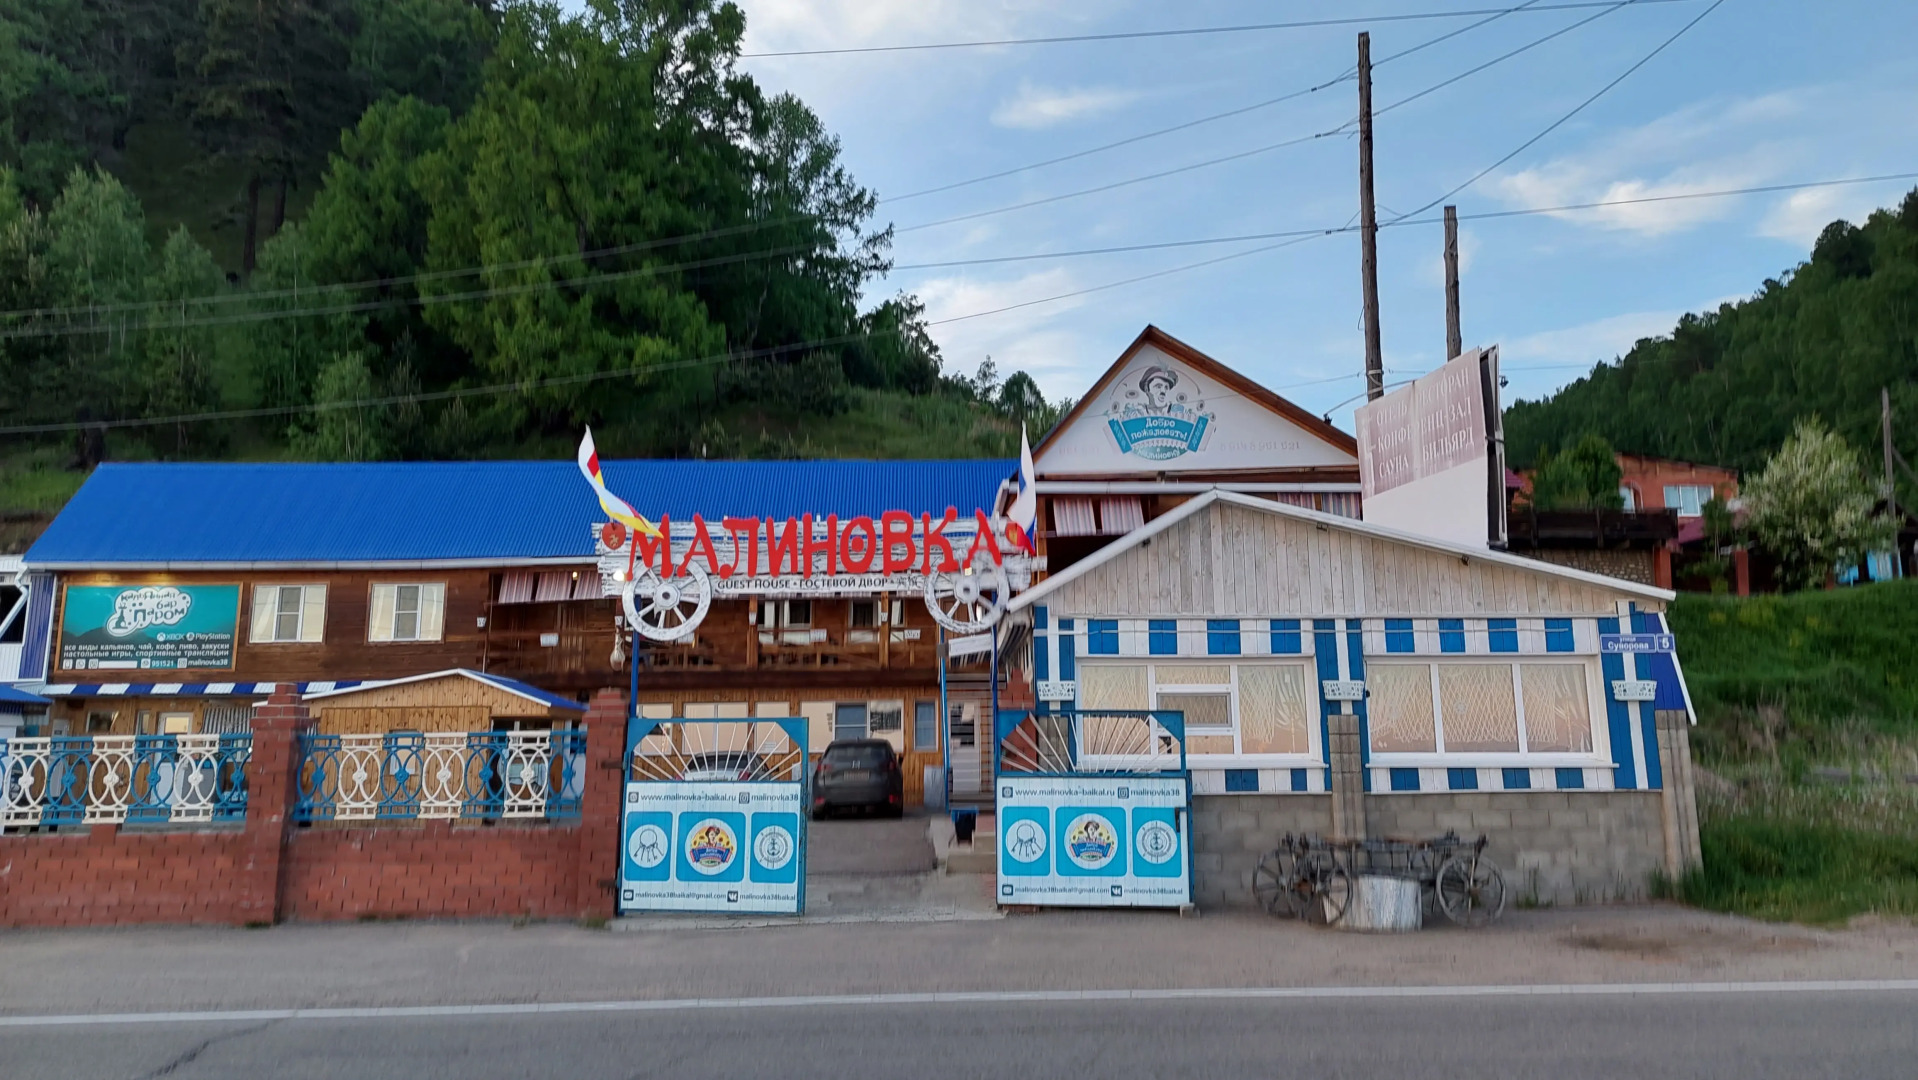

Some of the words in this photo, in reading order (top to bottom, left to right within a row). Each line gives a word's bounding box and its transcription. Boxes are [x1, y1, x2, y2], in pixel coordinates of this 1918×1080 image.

[1376, 400, 1407, 426] ОТЕЛЬ
[1417, 367, 1470, 409] ЕСТОРАН
[1145, 418, 1175, 428] Добро
[1131, 428, 1187, 440] пожаловать!
[1379, 453, 1409, 478] САУНА
[1422, 426, 1475, 462] БИЛЬЯРД
[624, 505, 1001, 582] МАЛИНОВКА
[717, 579, 750, 589] GUEST
[754, 578, 790, 589] HOUSE
[800, 577, 856, 588] ГОСТЕВОЙ
[858, 578, 888, 589] ДВОР
[156, 600, 177, 609] бар
[195, 632, 230, 641] PlayStation
[156, 642, 177, 650] кофе,
[201, 643, 229, 651] закуски
[1608, 641, 1649, 651] Суворова
[111, 650, 133, 658] игры,
[135, 650, 181, 658] спортивные
[184, 650, 229, 658] трансляции
[188, 658, 228, 666] malinovka38
[640, 792, 737, 801] www.malinovka-baikal.ru
[751, 792, 799, 801] malinovka38
[1015, 788, 1115, 797] www.malinovka-baikal.ru
[1130, 788, 1180, 797] malinovka38
[635, 890, 727, 900] malinovka38baikal@gmail.com
